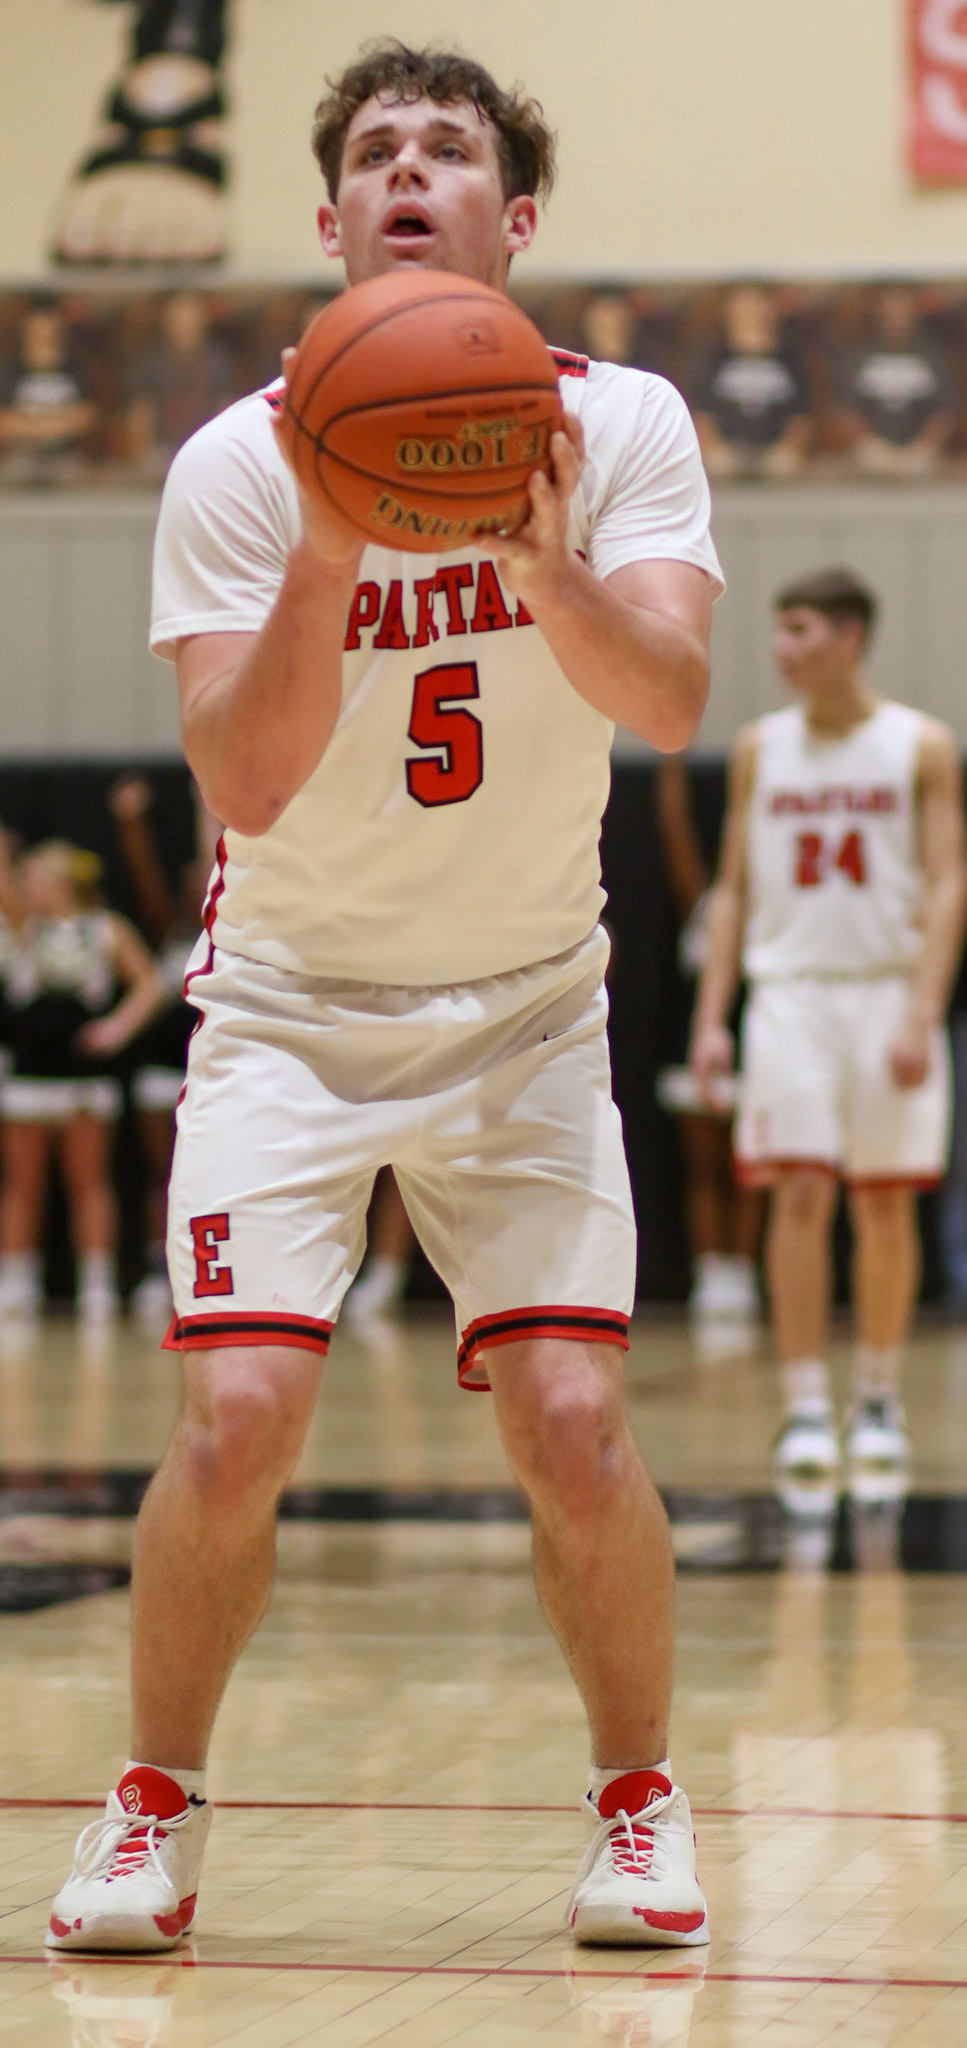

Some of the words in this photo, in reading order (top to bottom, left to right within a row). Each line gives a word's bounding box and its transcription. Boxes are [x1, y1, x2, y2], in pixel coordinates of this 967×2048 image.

[397, 433, 508, 471] 1000
[344, 549, 587, 651] PARTA
[405, 660, 483, 808] 5
[795, 830, 867, 887] 24
[189, 1212, 234, 1299] E
